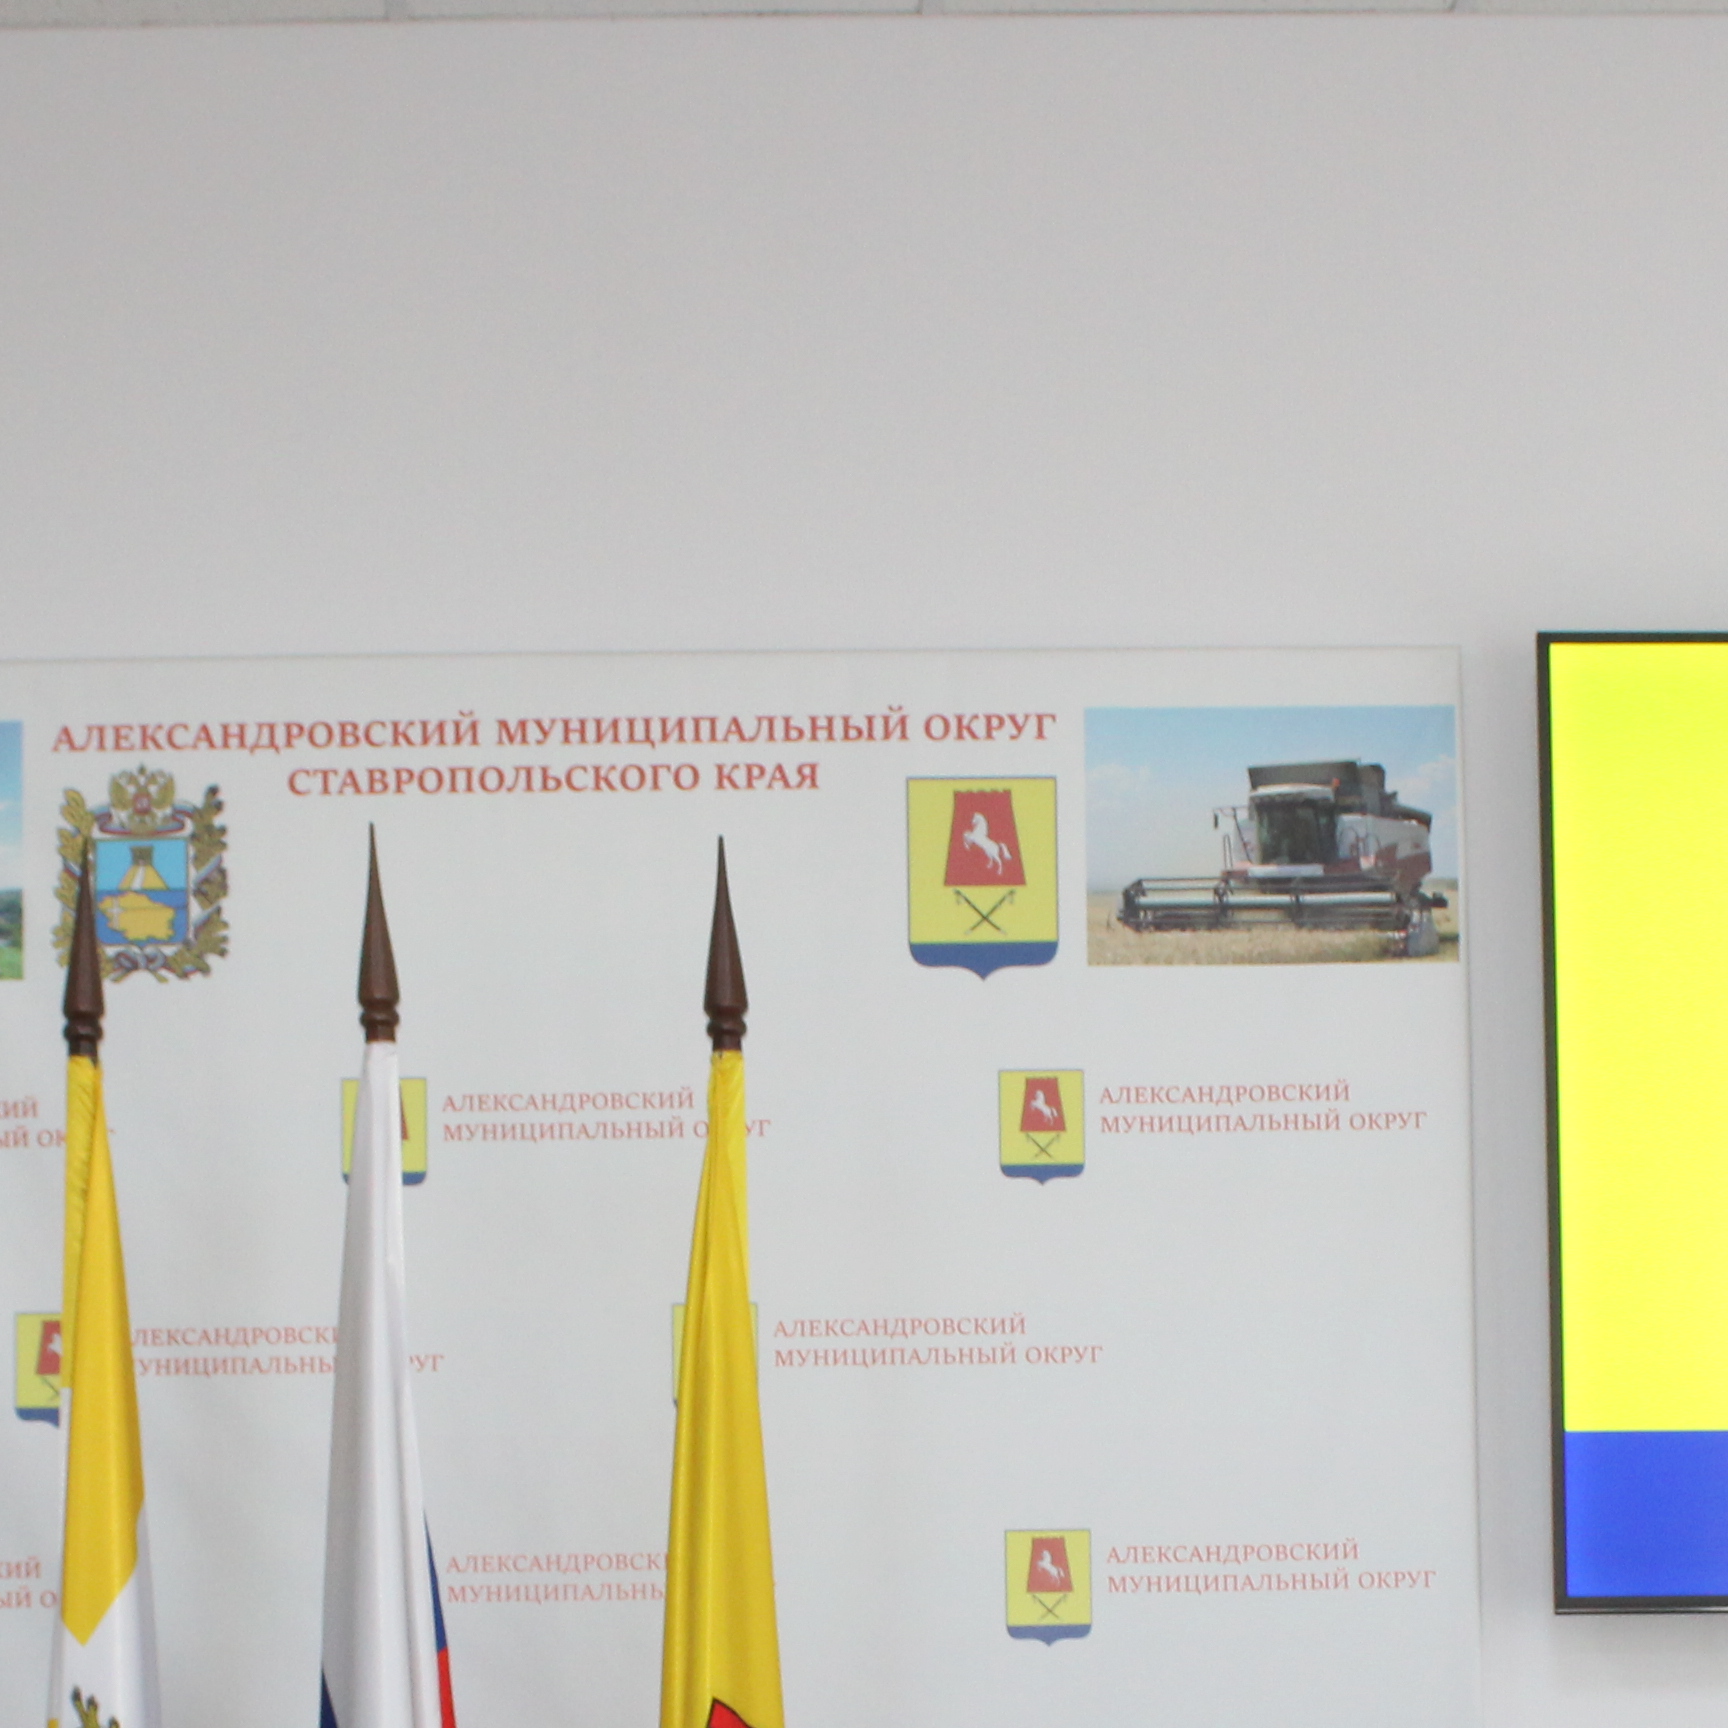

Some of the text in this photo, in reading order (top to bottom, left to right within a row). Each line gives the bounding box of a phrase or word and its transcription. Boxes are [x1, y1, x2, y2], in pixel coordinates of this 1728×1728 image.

[51, 706, 1057, 755] АЛЕКСАНДРОВСКИЙ МУНИЦИПАЛЬНЫЙ ОКРУГ
[287, 762, 820, 796] СТАВРОПОЛЬСКОГО КРАЯ
[443, 1087, 694, 1113] АЛЕКСАНДРОВСКИЙ
[1100, 1079, 1349, 1106] АЛЕКСАНДРОВСКИЙ
[444, 1116, 770, 1142] МУНИЦИПАЛЬНЫЙ ОУГ
[1101, 1108, 1426, 1135] МУНИЦИПАЛЬНЫЙ ОКРУГ
[132, 1326, 338, 1347] ЛЕКСАНДРОВСК
[774, 1313, 1026, 1339] АЛЕКСАНДРОВСКИЙ
[139, 1355, 335, 1377] УНИЦИПАЛЬНЫ
[775, 1342, 1103, 1368] МУНИЦИПАЛЬНЫЙ ОКРУГ
[446, 1552, 669, 1574] АЛЕКСАНДРОВСК
[1107, 1538, 1359, 1565] АЛЕКСАНДРОВСКИЙ
[1108, 1567, 1436, 1594] МУНИЦИПАЛЬНЫЙ ОКРУГ
